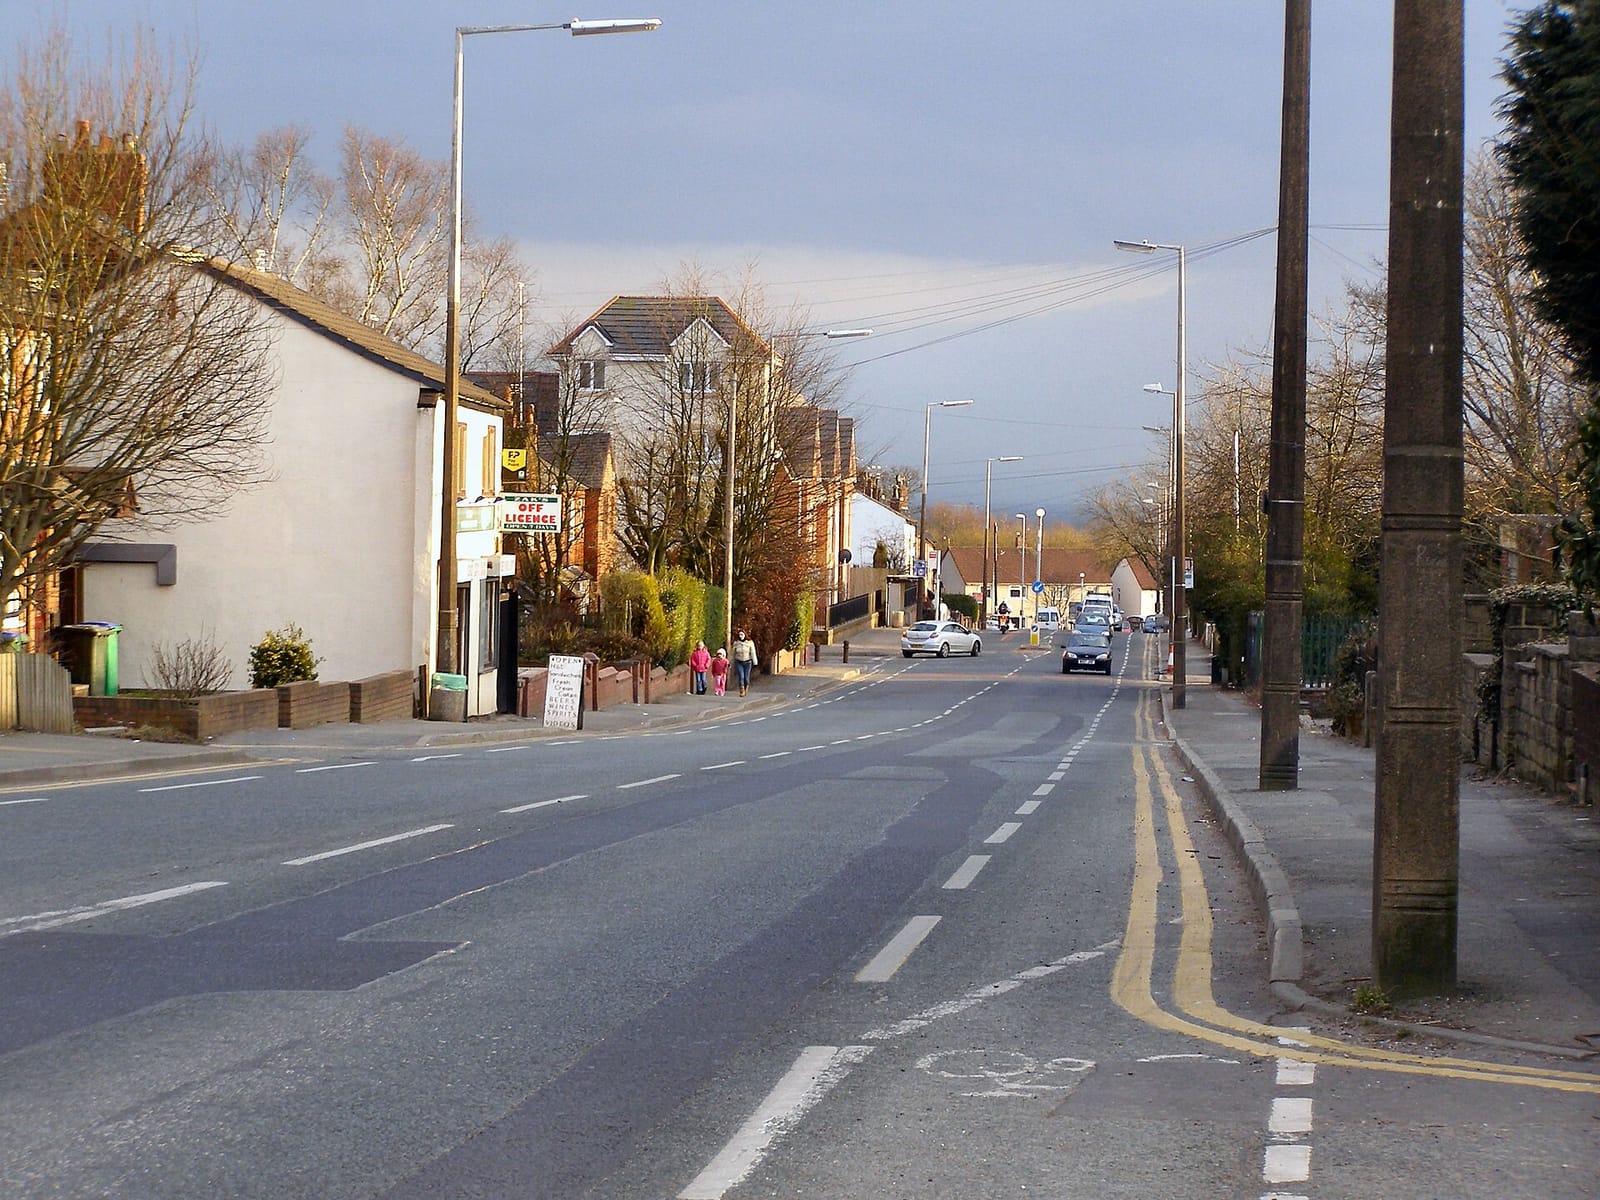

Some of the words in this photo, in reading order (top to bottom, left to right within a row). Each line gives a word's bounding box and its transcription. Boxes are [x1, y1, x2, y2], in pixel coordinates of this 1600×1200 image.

[518, 504, 544, 512] OFF
[505, 514, 556, 524] LICENCE
[549, 696, 575, 704] BEERS
[548, 703, 574, 711] WINES
[547, 710, 577, 718] SPIRITS
[545, 720, 576, 729] VIDEOS
